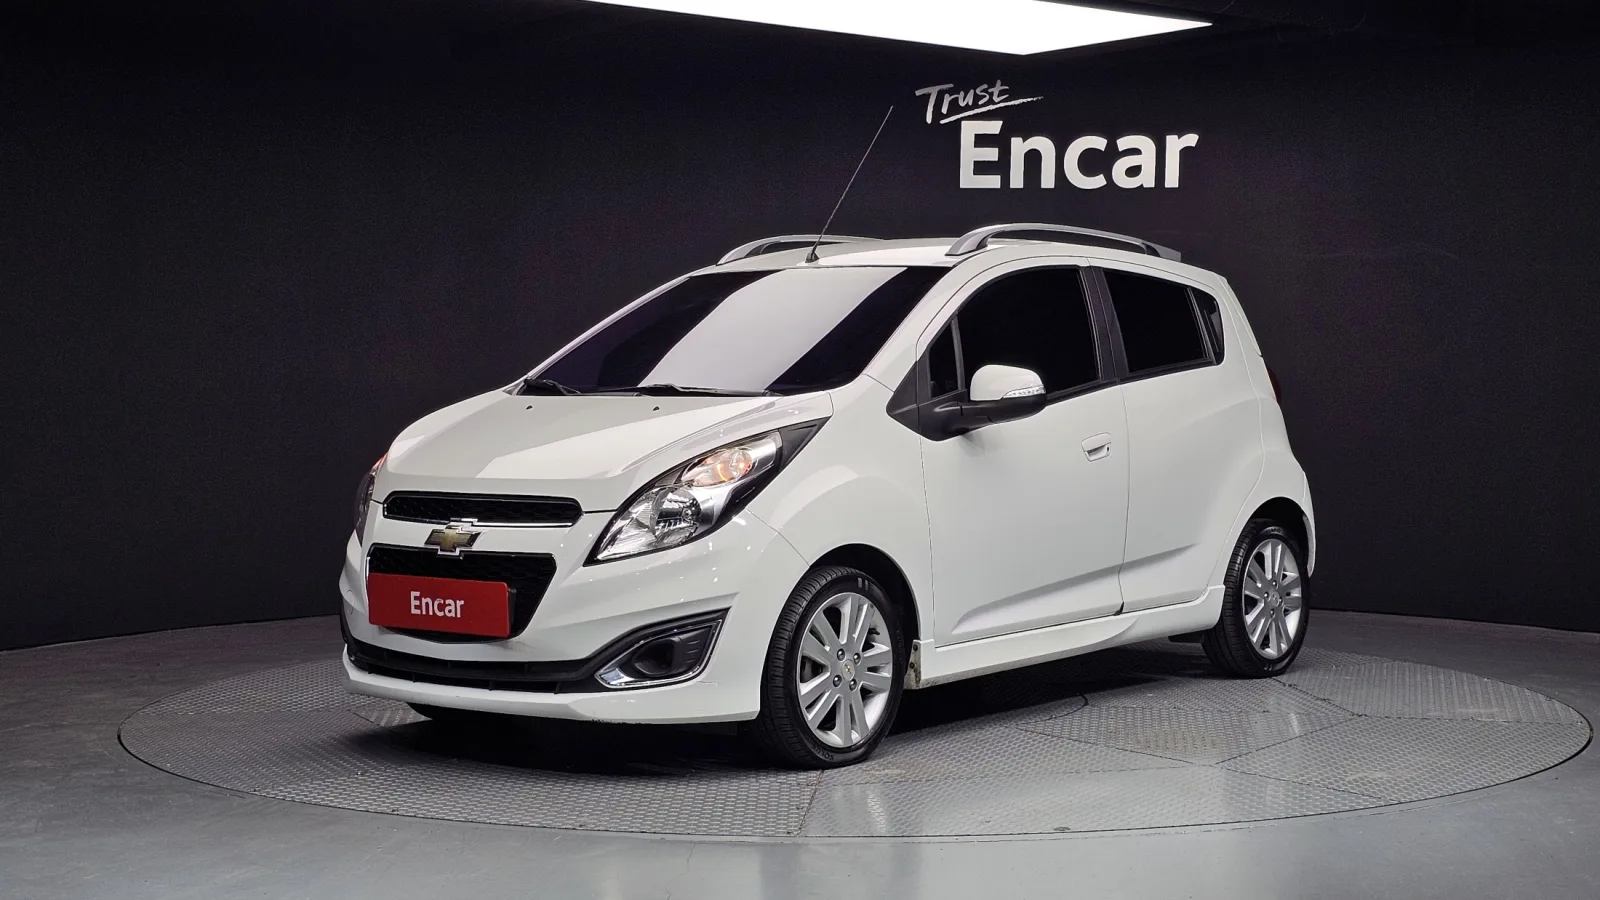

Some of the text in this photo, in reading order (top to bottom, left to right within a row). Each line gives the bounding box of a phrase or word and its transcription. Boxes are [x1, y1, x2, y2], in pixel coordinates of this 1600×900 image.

[915, 80, 1010, 124] Trust
[960, 121, 1199, 189] Encar
[410, 591, 465, 618] Encar
